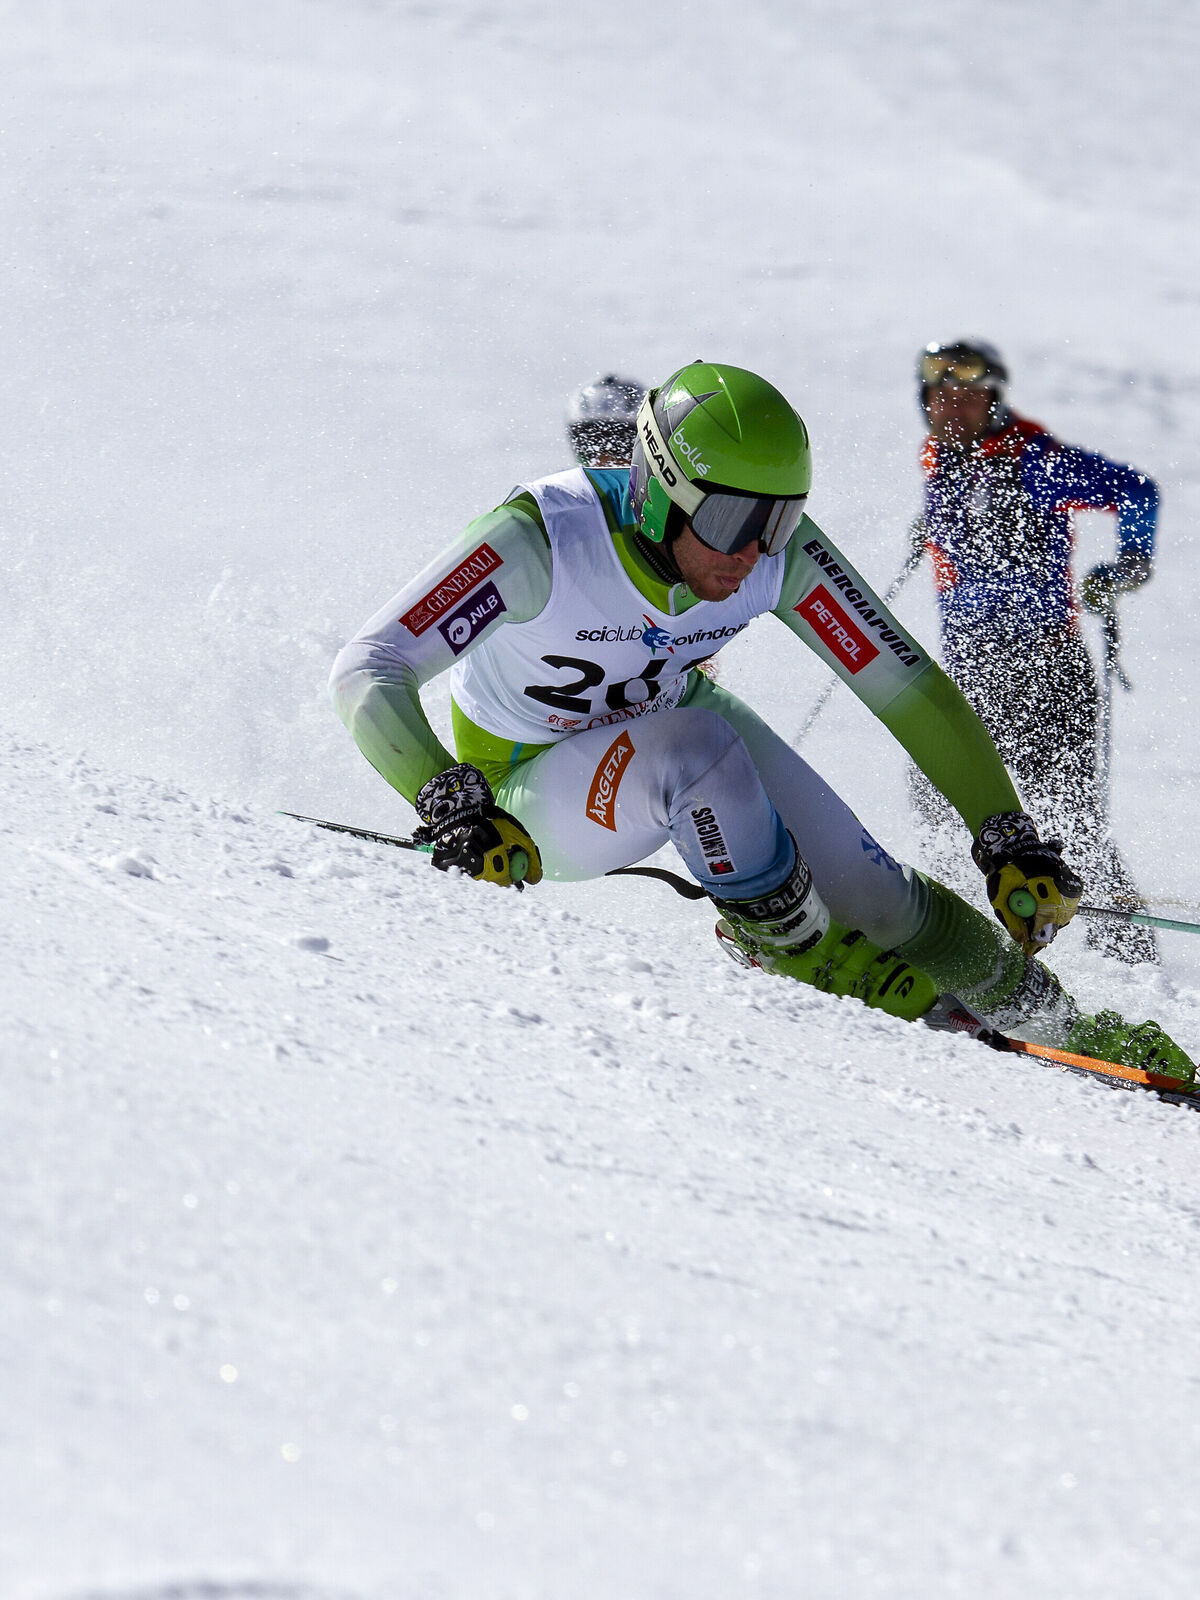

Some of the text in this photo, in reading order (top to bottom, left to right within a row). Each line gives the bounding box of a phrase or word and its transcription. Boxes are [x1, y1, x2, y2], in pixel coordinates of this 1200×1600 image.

[643, 421, 677, 488] HEAD
[673, 427, 711, 477] bollé
[426, 549, 496, 613] GENERALI
[469, 594, 499, 625] NLB
[575, 625, 643, 642] sciclub
[809, 599, 863, 663] PETROL
[589, 745, 629, 825] ARGETA
[691, 806, 728, 859] AMICUS
